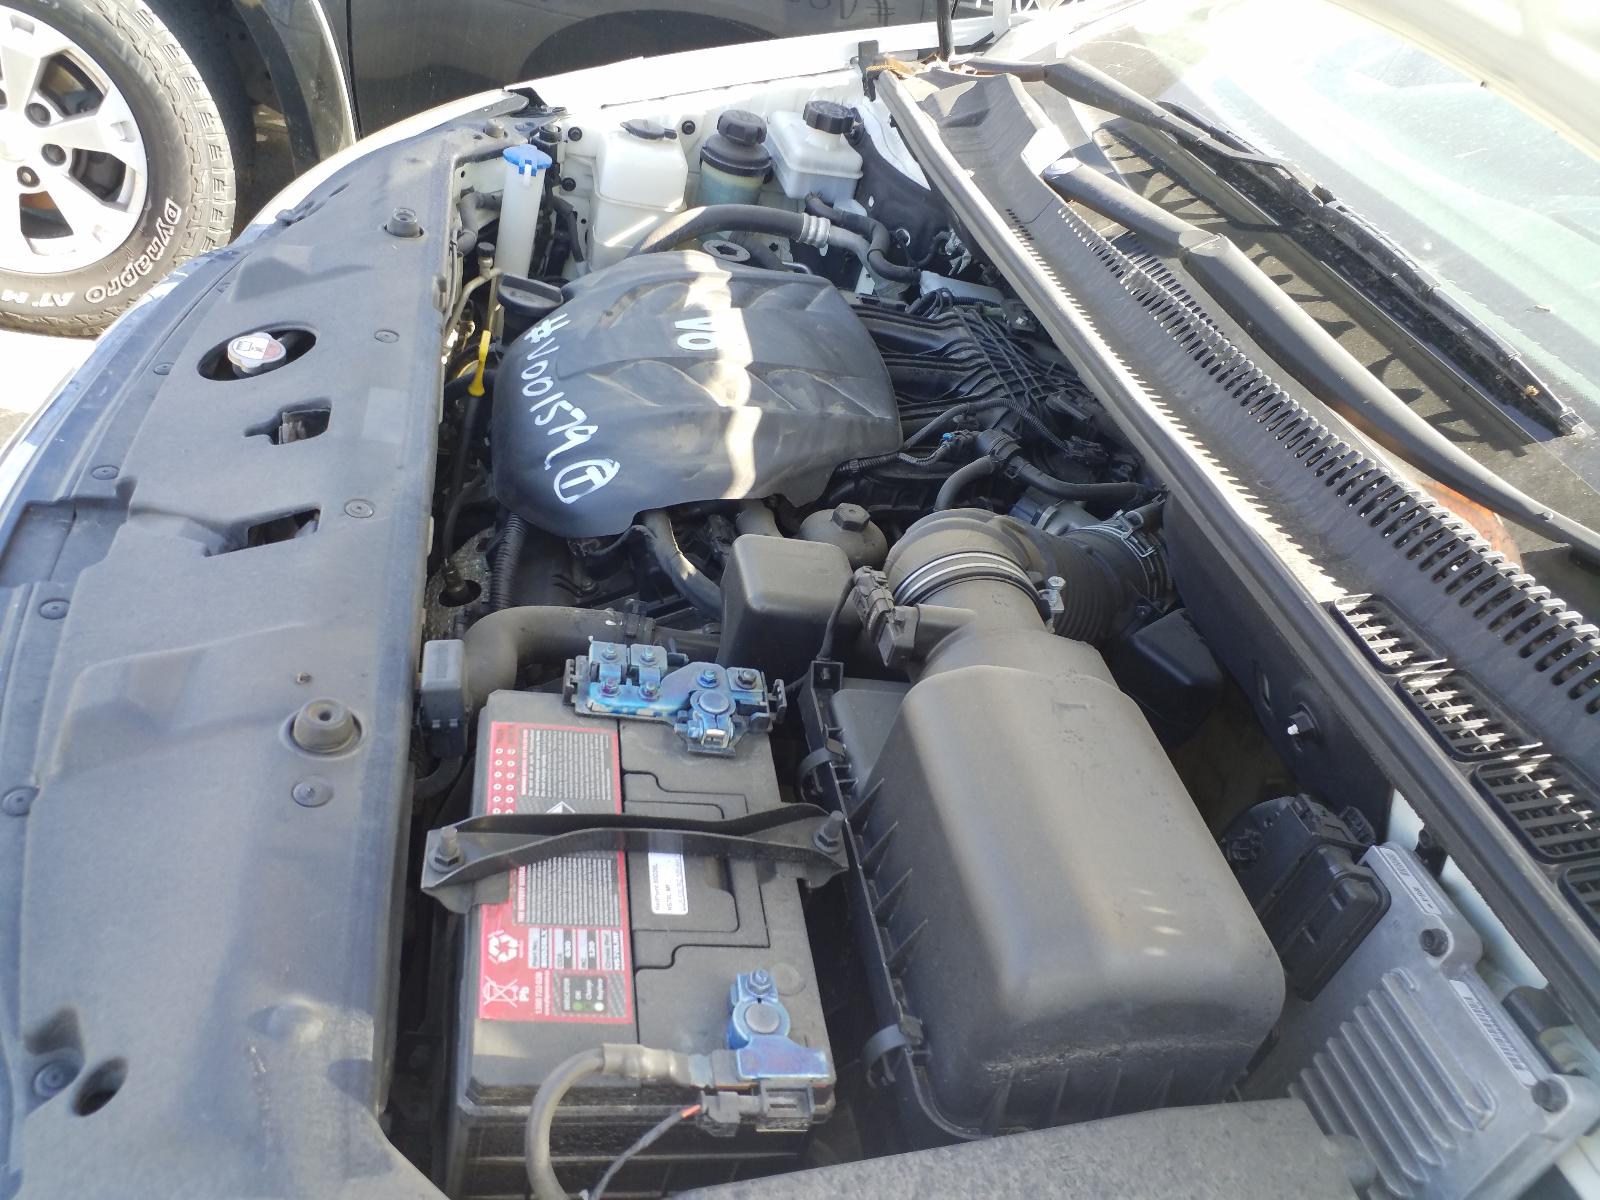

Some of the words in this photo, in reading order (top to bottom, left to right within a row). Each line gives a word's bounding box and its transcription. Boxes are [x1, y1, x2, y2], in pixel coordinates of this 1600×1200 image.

[519, 987, 529, 1002] Pb
[575, 990, 582, 1001] OK
[585, 980, 593, 1001] Charge
